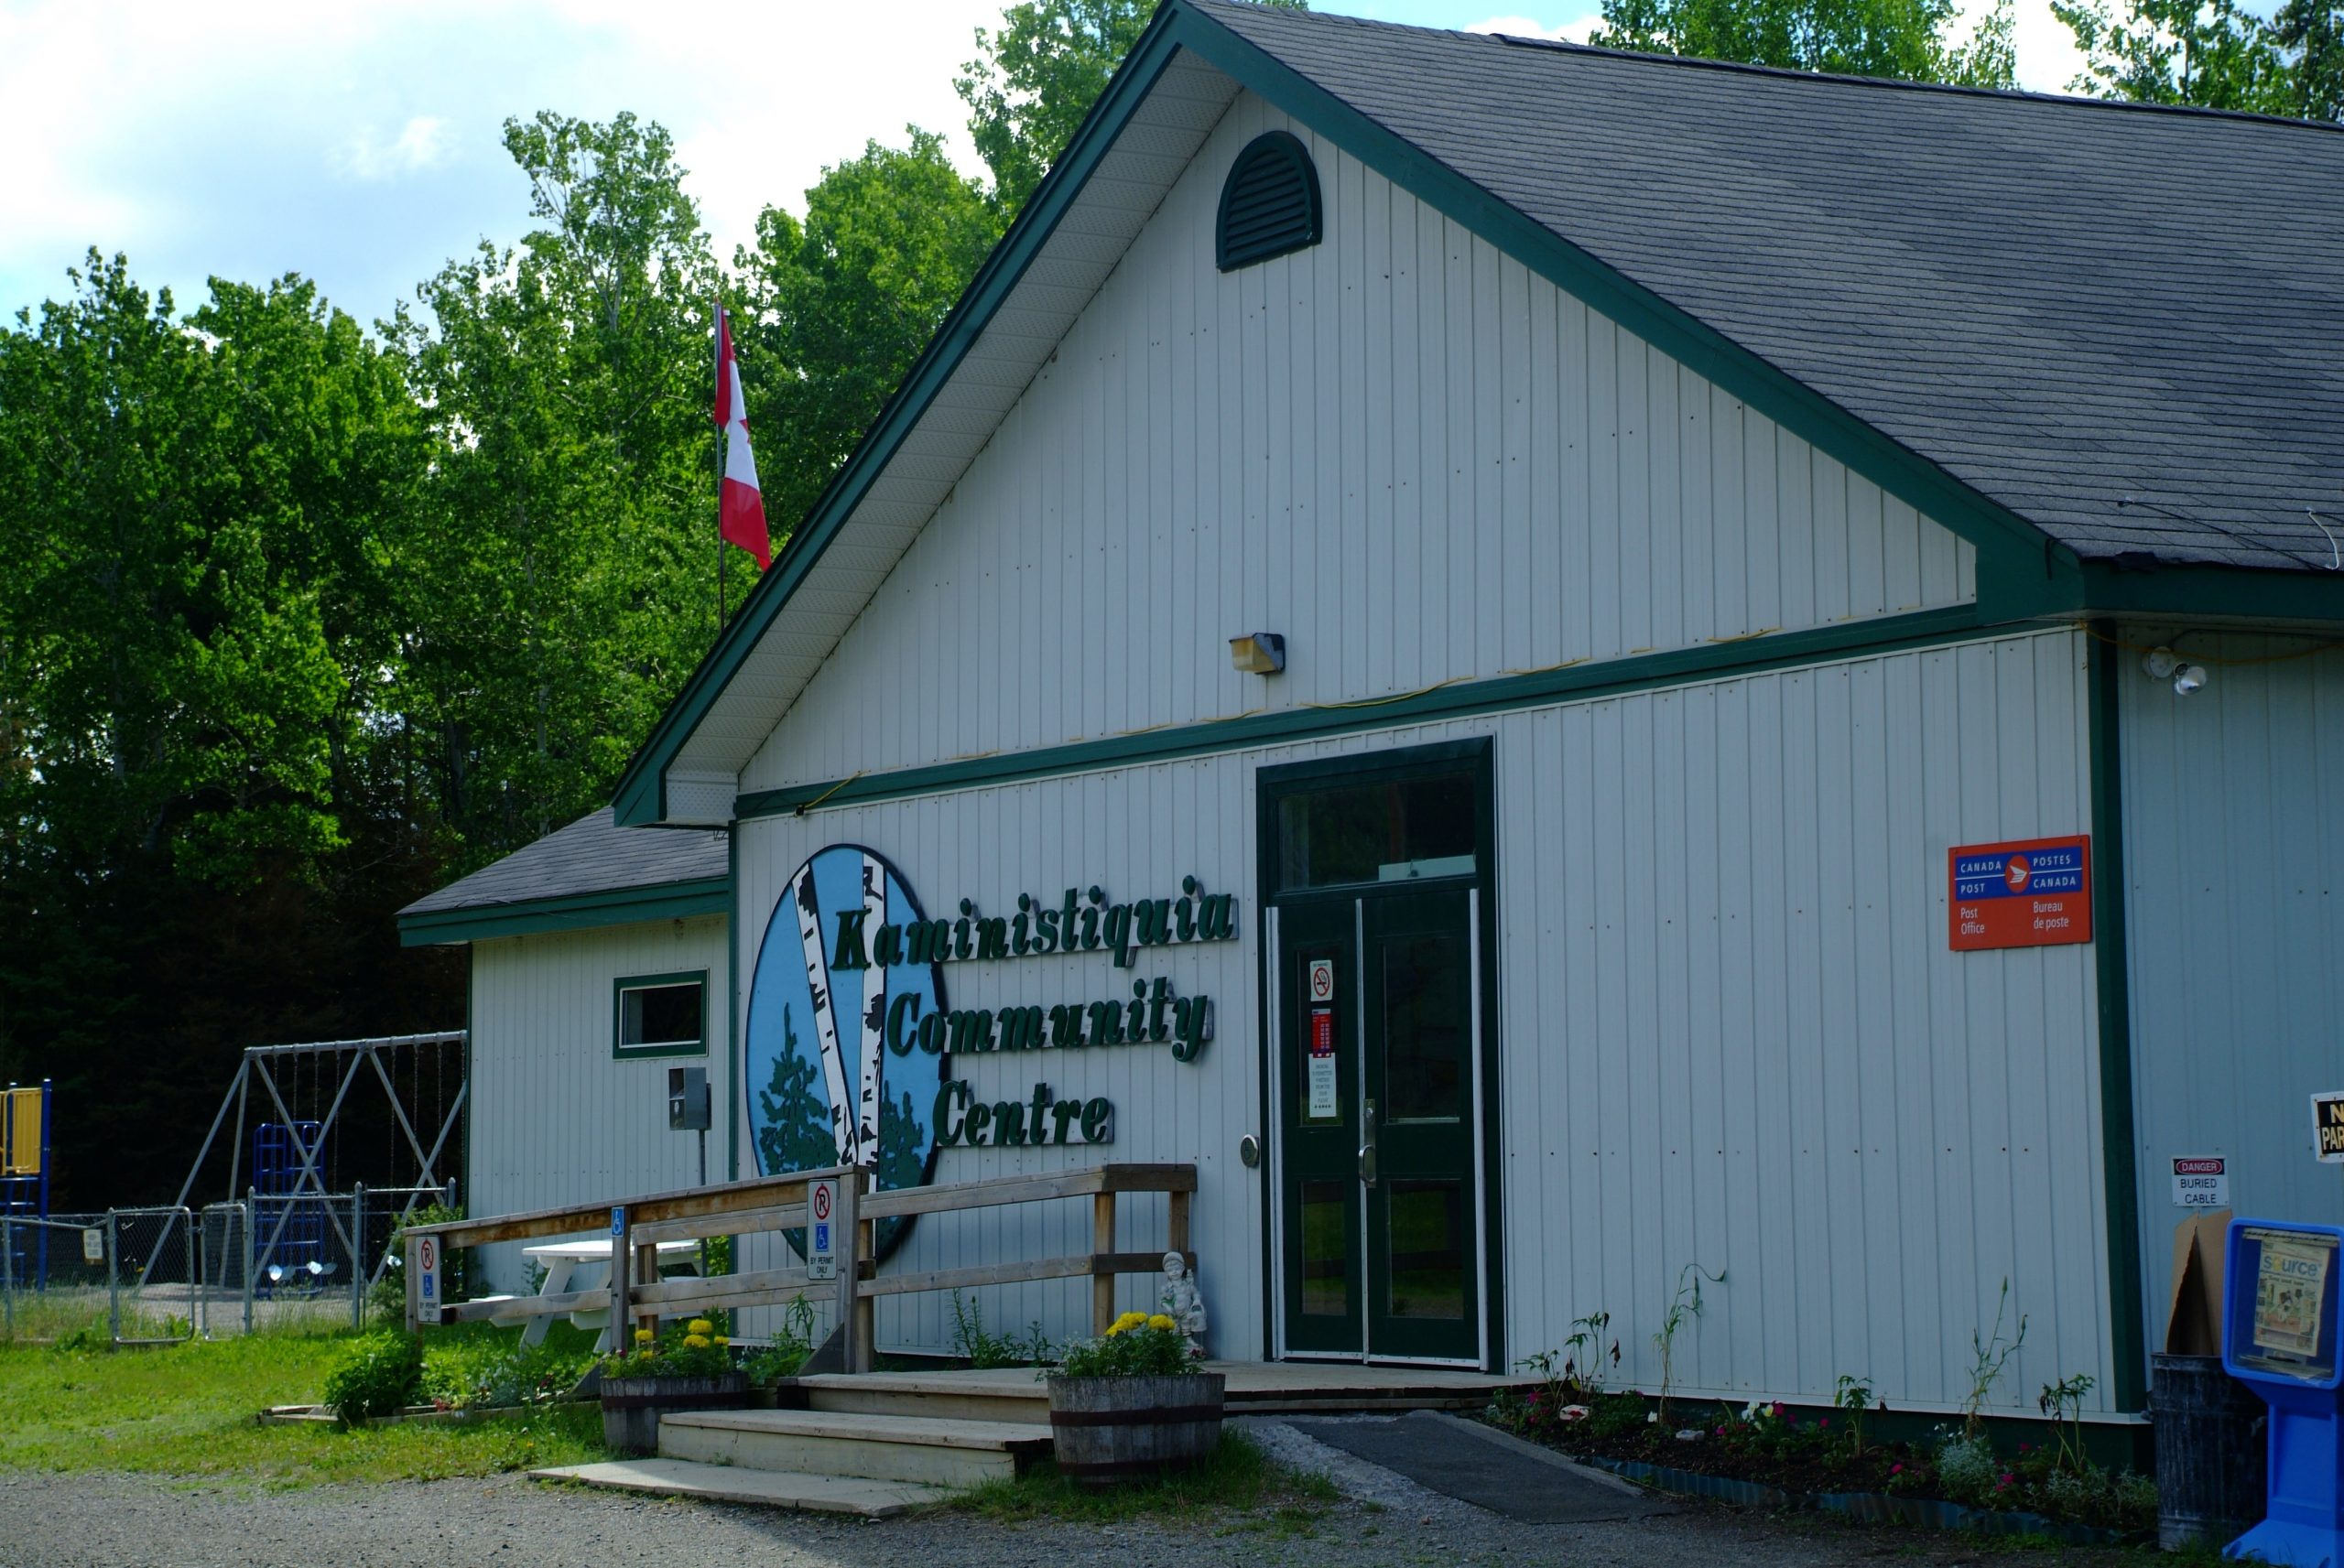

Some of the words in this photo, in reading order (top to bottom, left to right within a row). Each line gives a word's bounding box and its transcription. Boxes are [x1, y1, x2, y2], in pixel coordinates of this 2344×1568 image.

[1960, 860, 2002, 873] CANADA
[2033, 854, 2071, 867] POSTES
[1960, 882, 1985, 894] POST
[2033, 876, 2077, 889] CANADA
[1960, 907, 1978, 919] Post
[2033, 901, 2063, 914] Bureau
[831, 875, 1233, 970] Kaministiquia
[1960, 922, 1985, 935] Office
[2034, 917, 2044, 929] de
[2046, 916, 2069, 931] poste
[886, 977, 1208, 1063] Community
[932, 1079, 1110, 1147] Centre
[2181, 1162, 2217, 1173] DANGER
[2180, 1178, 2217, 1189] BURIED
[2185, 1194, 2217, 1204] CABLE
[818, 1256, 834, 1264] PERMIT
[817, 1266, 828, 1274] ONLY
